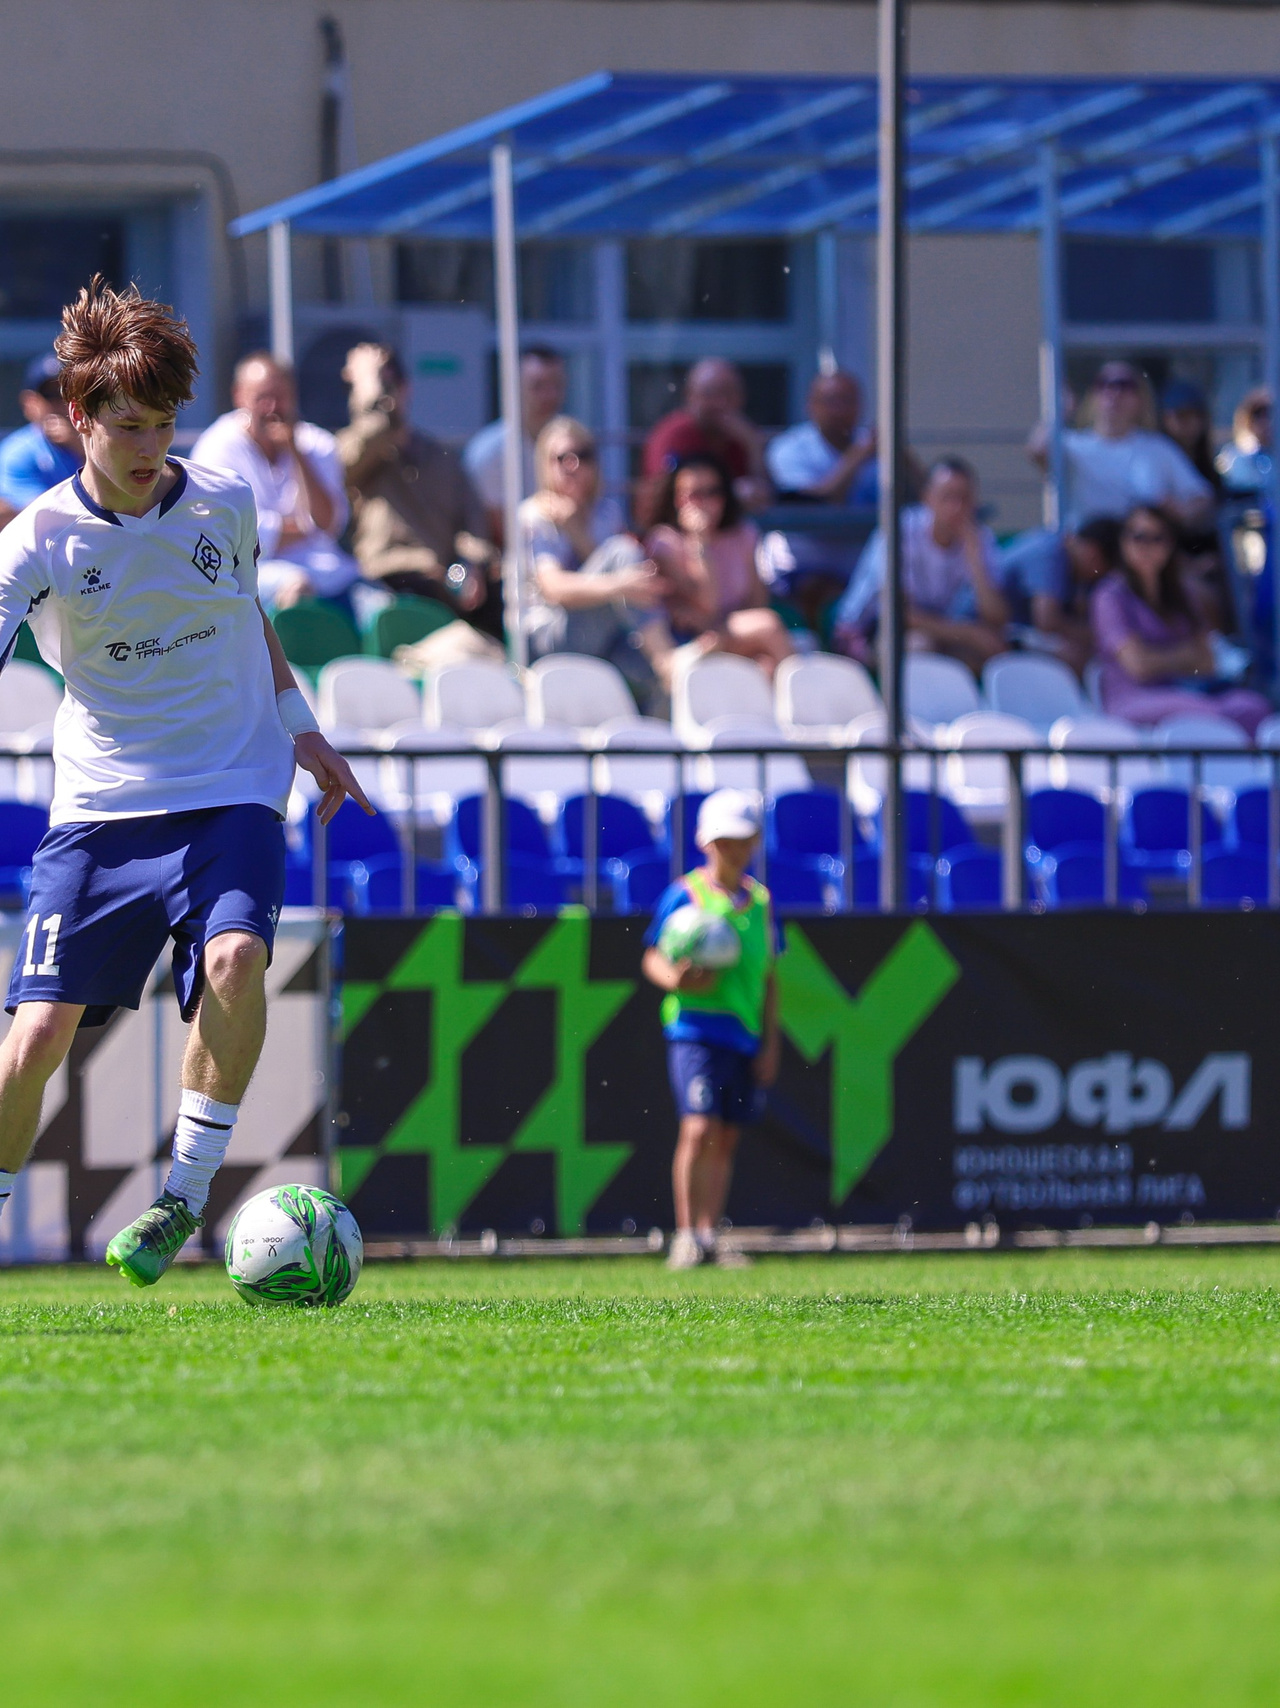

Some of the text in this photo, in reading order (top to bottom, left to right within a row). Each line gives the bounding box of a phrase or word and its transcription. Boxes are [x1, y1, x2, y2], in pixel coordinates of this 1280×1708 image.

[80, 583, 111, 595] KELME
[134, 637, 161, 651] ДСК
[22, 913, 62, 977] 11
[955, 1052, 1251, 1132] ЮФЛ
